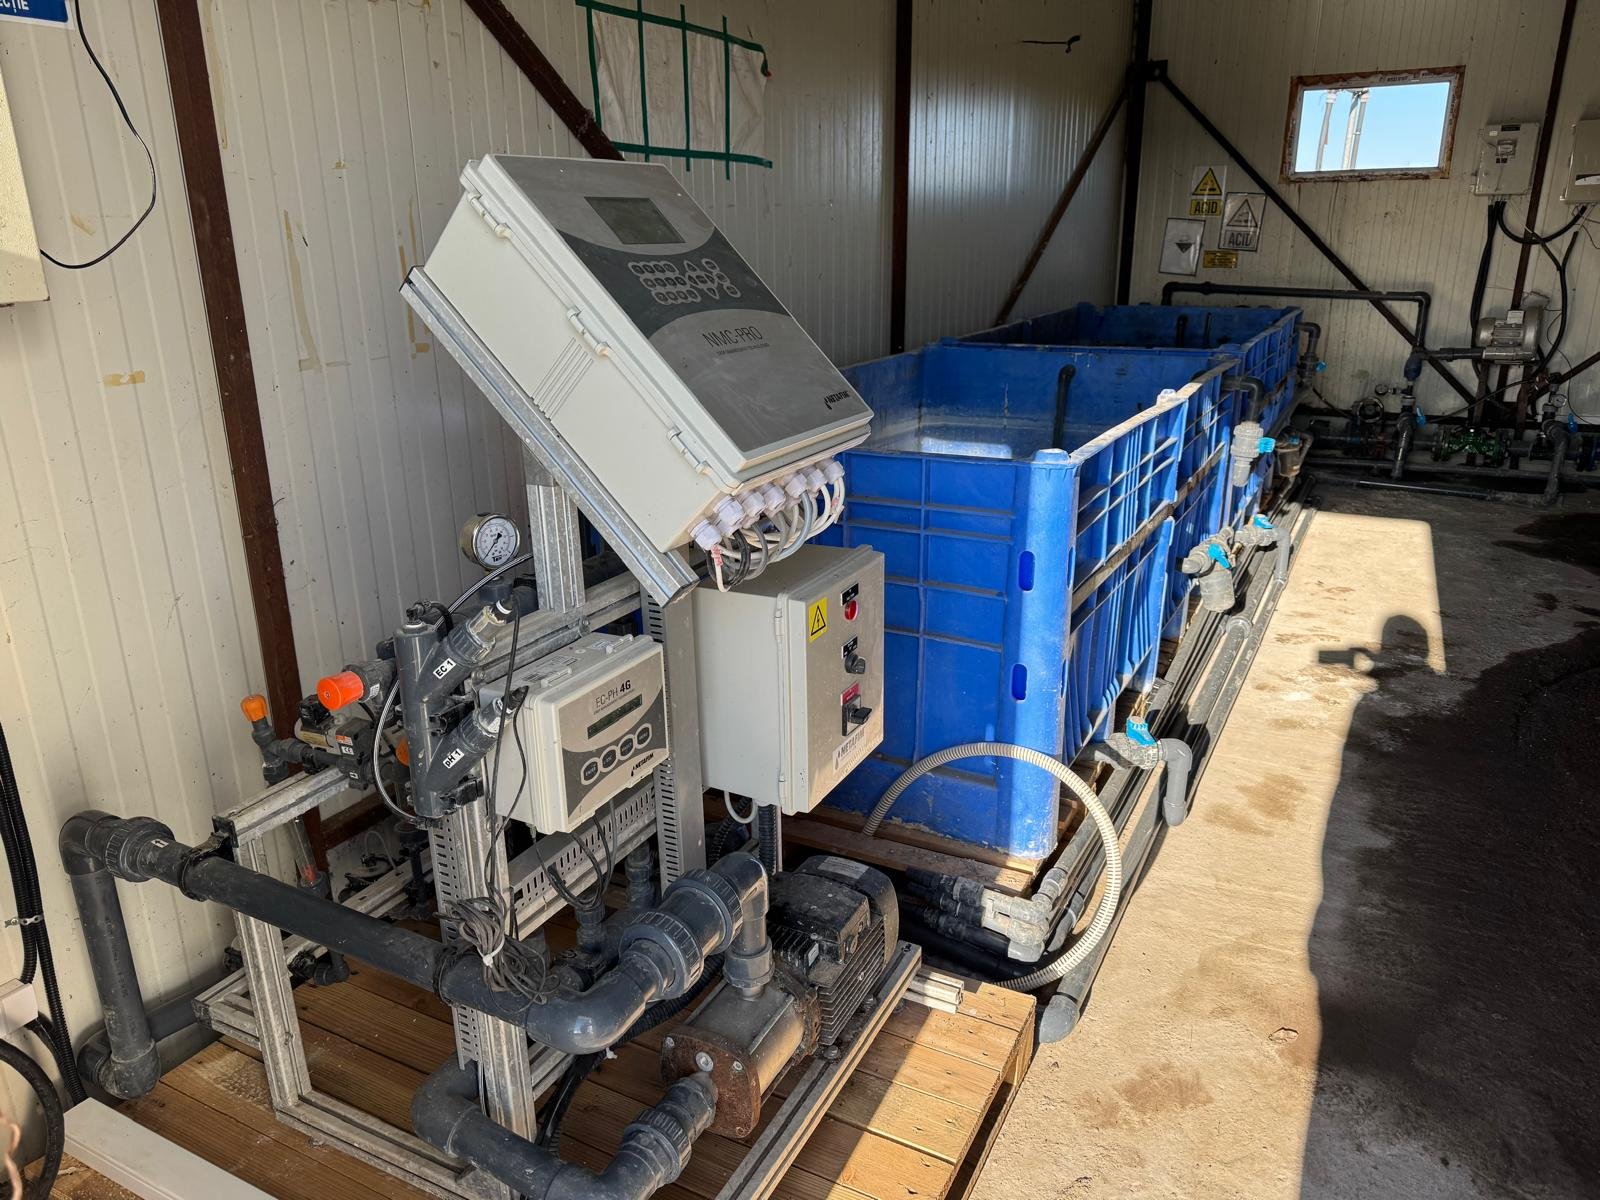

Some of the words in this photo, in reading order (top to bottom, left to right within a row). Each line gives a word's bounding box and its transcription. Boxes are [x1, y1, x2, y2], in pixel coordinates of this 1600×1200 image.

[1194, 201, 1218, 214] ACID
[1228, 232, 1252, 247] ACID
[702, 326, 763, 348] NMC-PRO
[435, 665, 448, 677] EC
[595, 687, 619, 709] EC-PH
[619, 679, 631, 693] 4G
[445, 754, 456, 767] pH
